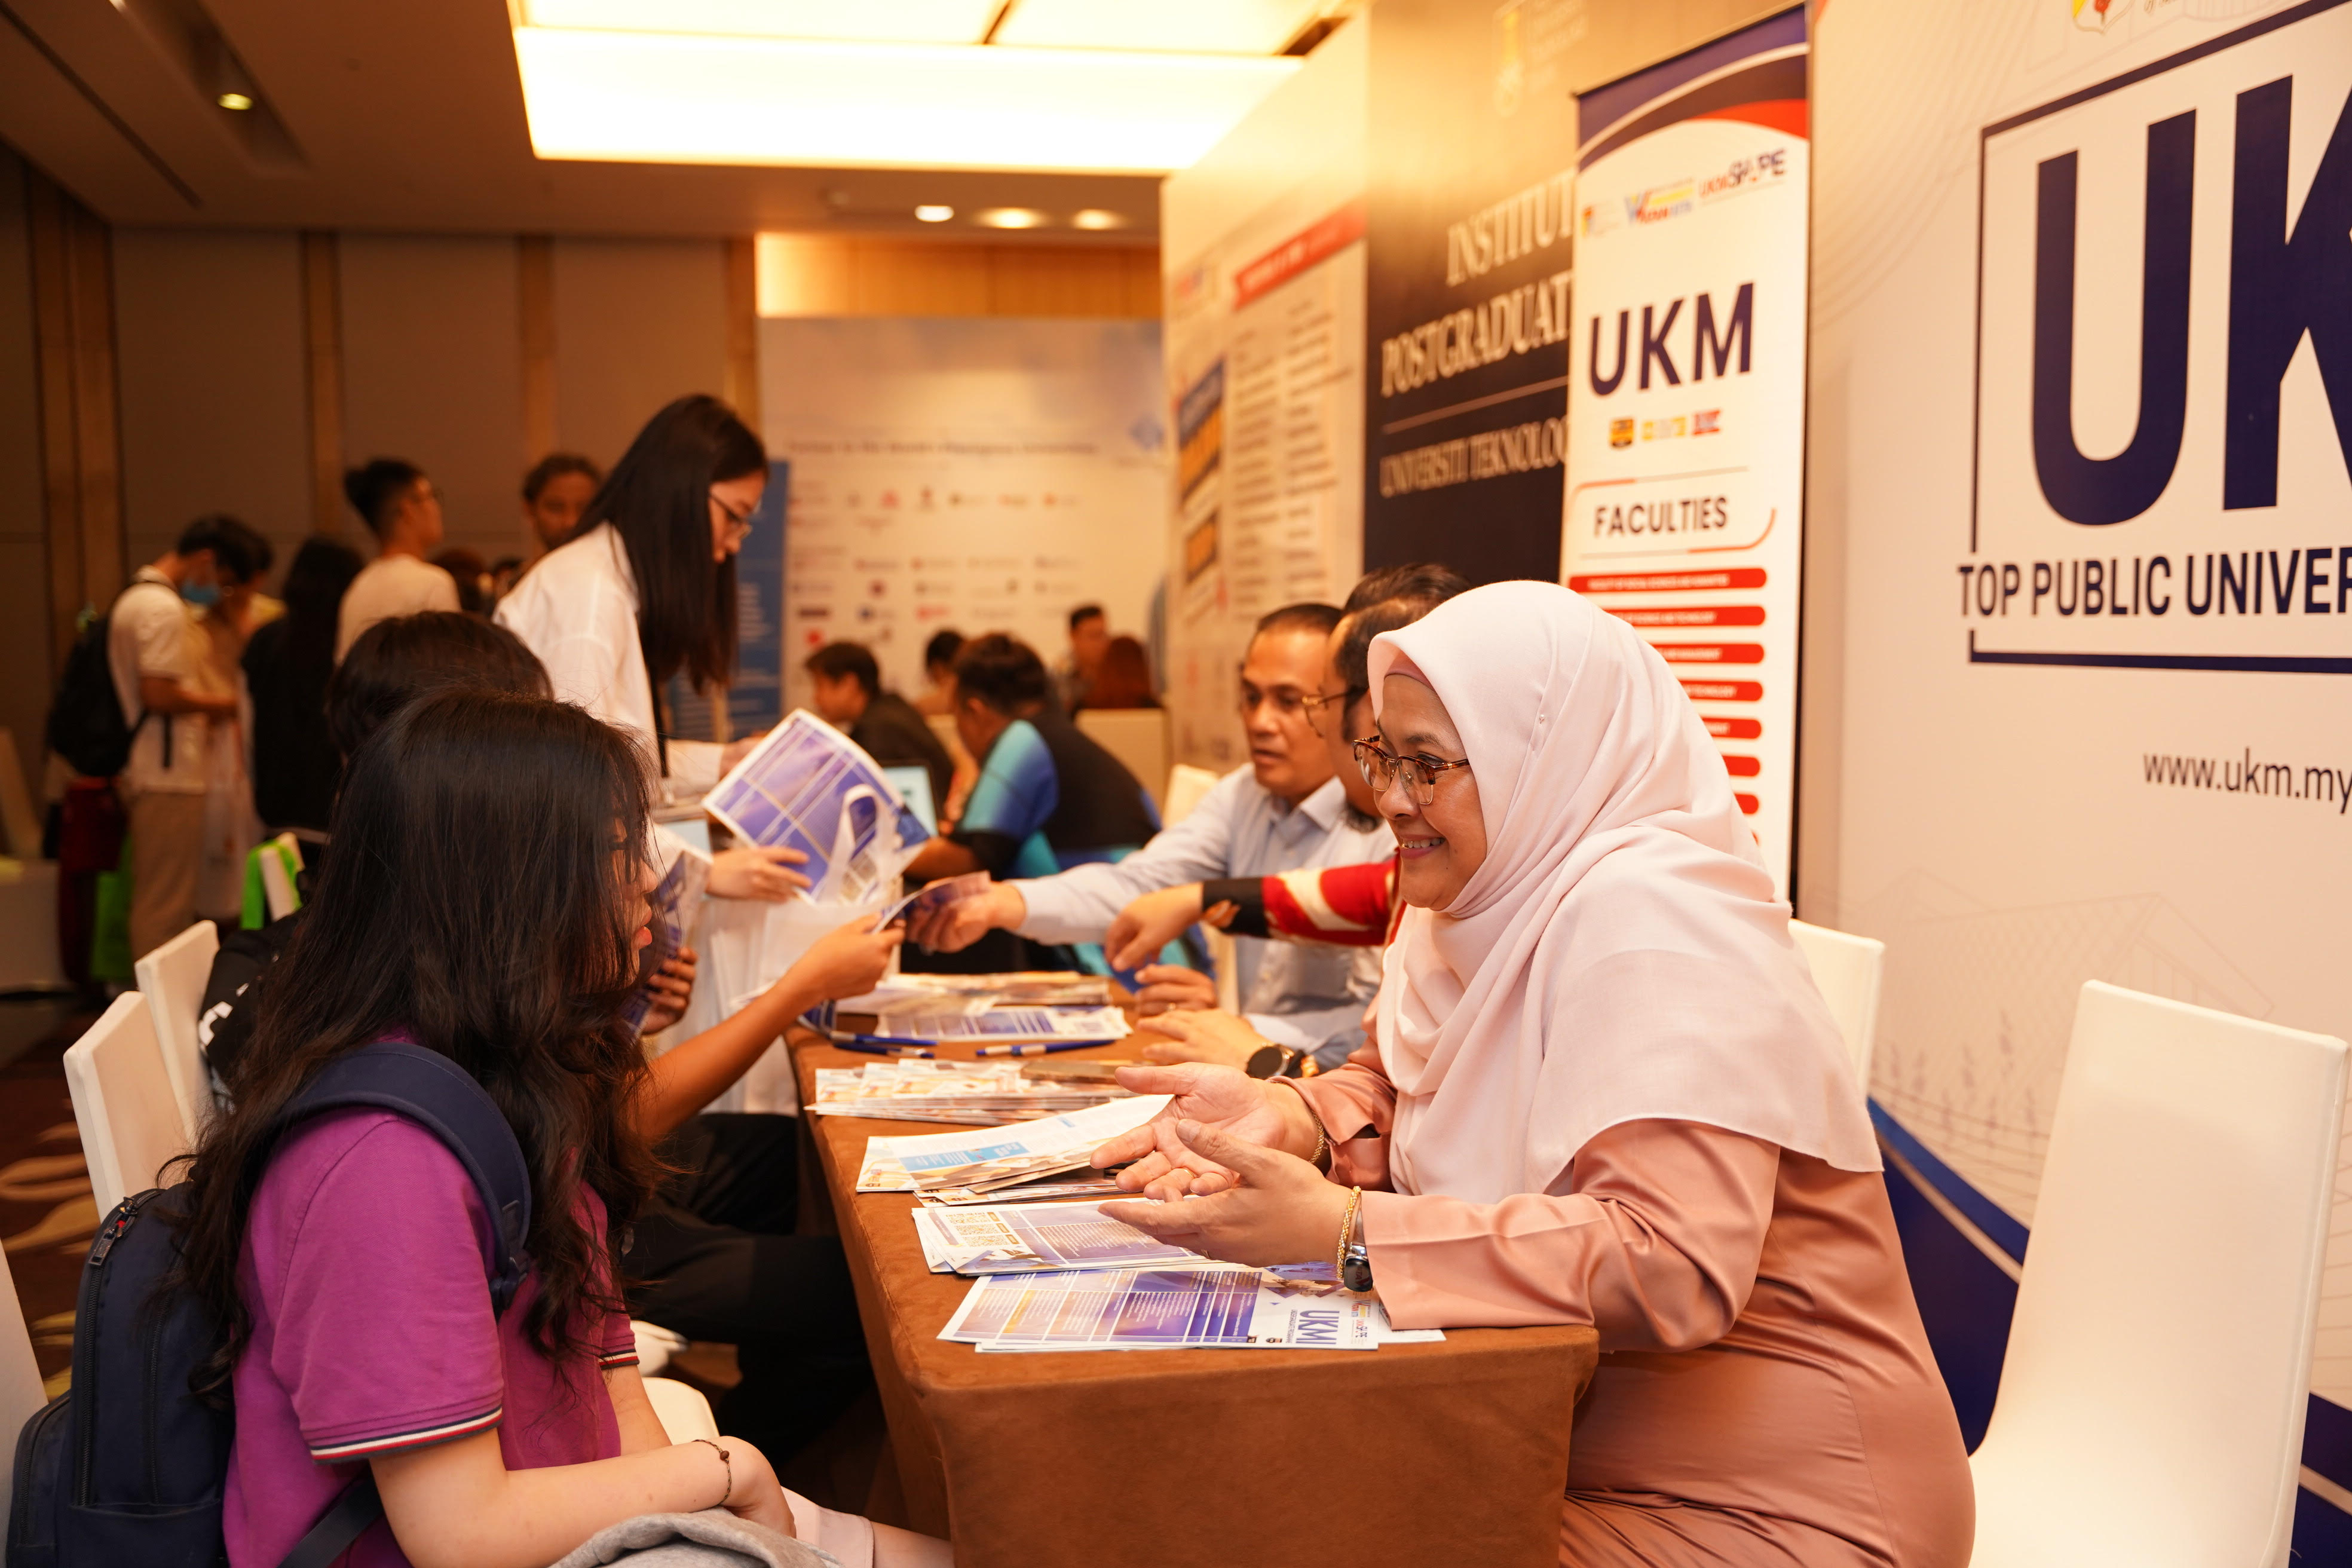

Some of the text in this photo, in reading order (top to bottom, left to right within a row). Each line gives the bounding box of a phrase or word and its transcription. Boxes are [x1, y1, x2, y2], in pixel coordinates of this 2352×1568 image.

[1590, 281, 1754, 398] UKM
[1593, 497, 1729, 537] FACULTIES
[1957, 562, 2022, 617] TOP
[2031, 555, 2172, 616] PUBLIC
[2143, 746, 2352, 815] www.ukm.my
